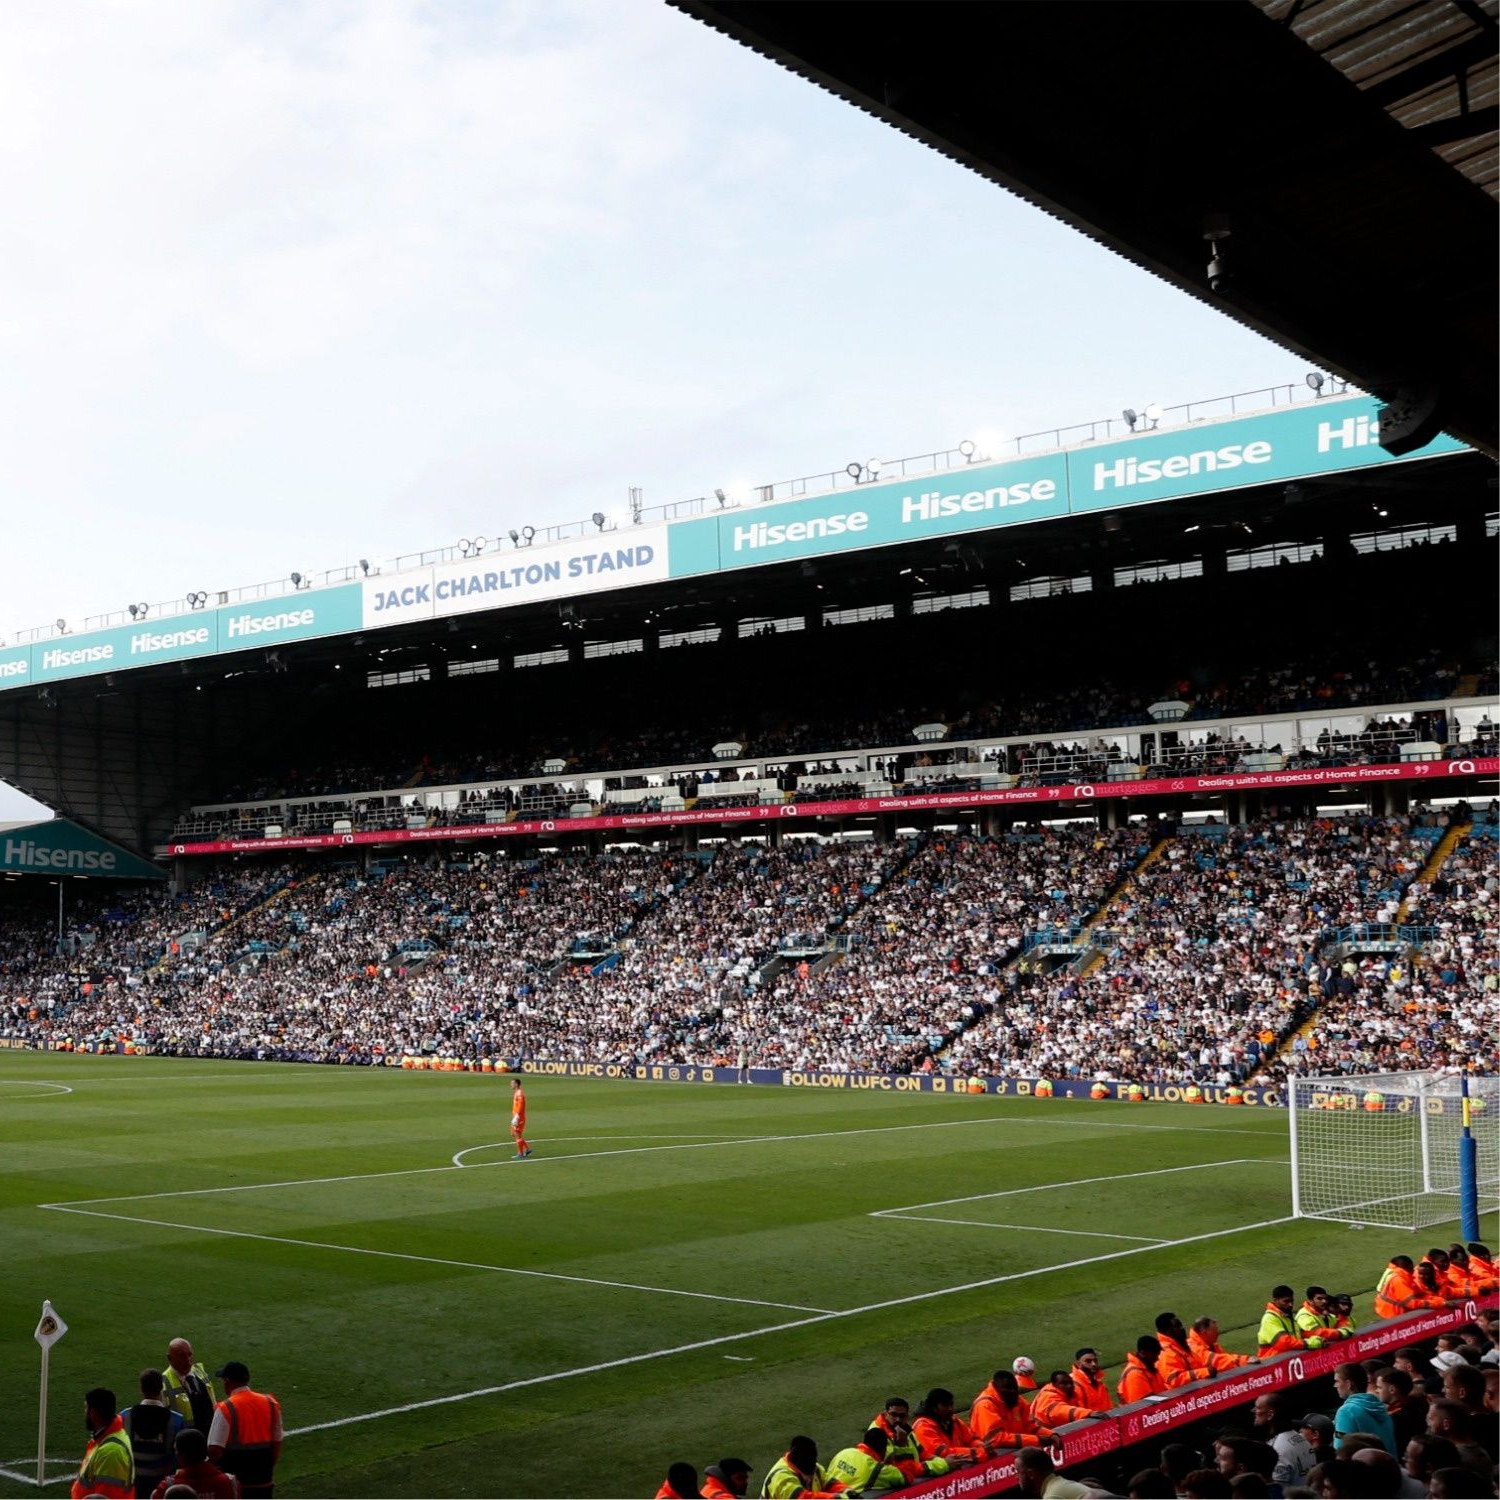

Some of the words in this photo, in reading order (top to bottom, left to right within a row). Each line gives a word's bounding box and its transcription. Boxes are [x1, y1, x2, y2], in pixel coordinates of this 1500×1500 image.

[1093, 441, 1272, 491] Hisense
[901, 478, 1055, 523] Hisense
[733, 511, 869, 551] Hisense
[374, 584, 430, 611] JACK
[436, 560, 560, 600] CHARLTON
[568, 545, 654, 578] STAND
[228, 608, 315, 638] Hisense
[130, 627, 209, 654] Hisense
[42, 644, 114, 670] Hisense
[1096, 782, 1158, 795] mortgages
[1198, 779, 1234, 788] Dealing
[1236, 776, 1258, 785] with
[1260, 775, 1273, 783] all
[1274, 774, 1312, 784] aspects
[1314, 772, 1325, 780] of
[1326, 770, 1356, 779] Home
[1359, 768, 1401, 777] Finance
[879, 799, 908, 808] Dealing
[909, 797, 927, 806] with
[928, 796, 939, 804] all
[940, 795, 969, 805] aspects
[970, 794, 979, 802] of
[980, 793, 1004, 801] Home
[1005, 791, 1037, 800] Finance
[622, 816, 646, 824] Dealing
[672, 813, 695, 822] aspects
[704, 811, 723, 819] Home
[4, 839, 116, 870] Hisense
[522, 1061, 567, 1074] OLLOW
[570, 1062, 603, 1076] LUFC
[790, 1072, 847, 1088] OLLOW
[850, 1074, 892, 1090] LUFC
[895, 1076, 921, 1091] ON
[1142, 1409, 1170, 1428] Dealing
[1170, 1401, 1186, 1418] with
[1187, 1397, 1197, 1413] all
[1196, 1390, 1221, 1410] aspects
[1221, 1385, 1229, 1399] of
[1229, 1382, 1248, 1397] Home
[1248, 1374, 1273, 1390] Finance
[836, 1459, 857, 1477] SENIOR
[946, 1479, 956, 1498] of
[957, 1474, 985, 1494] Home
